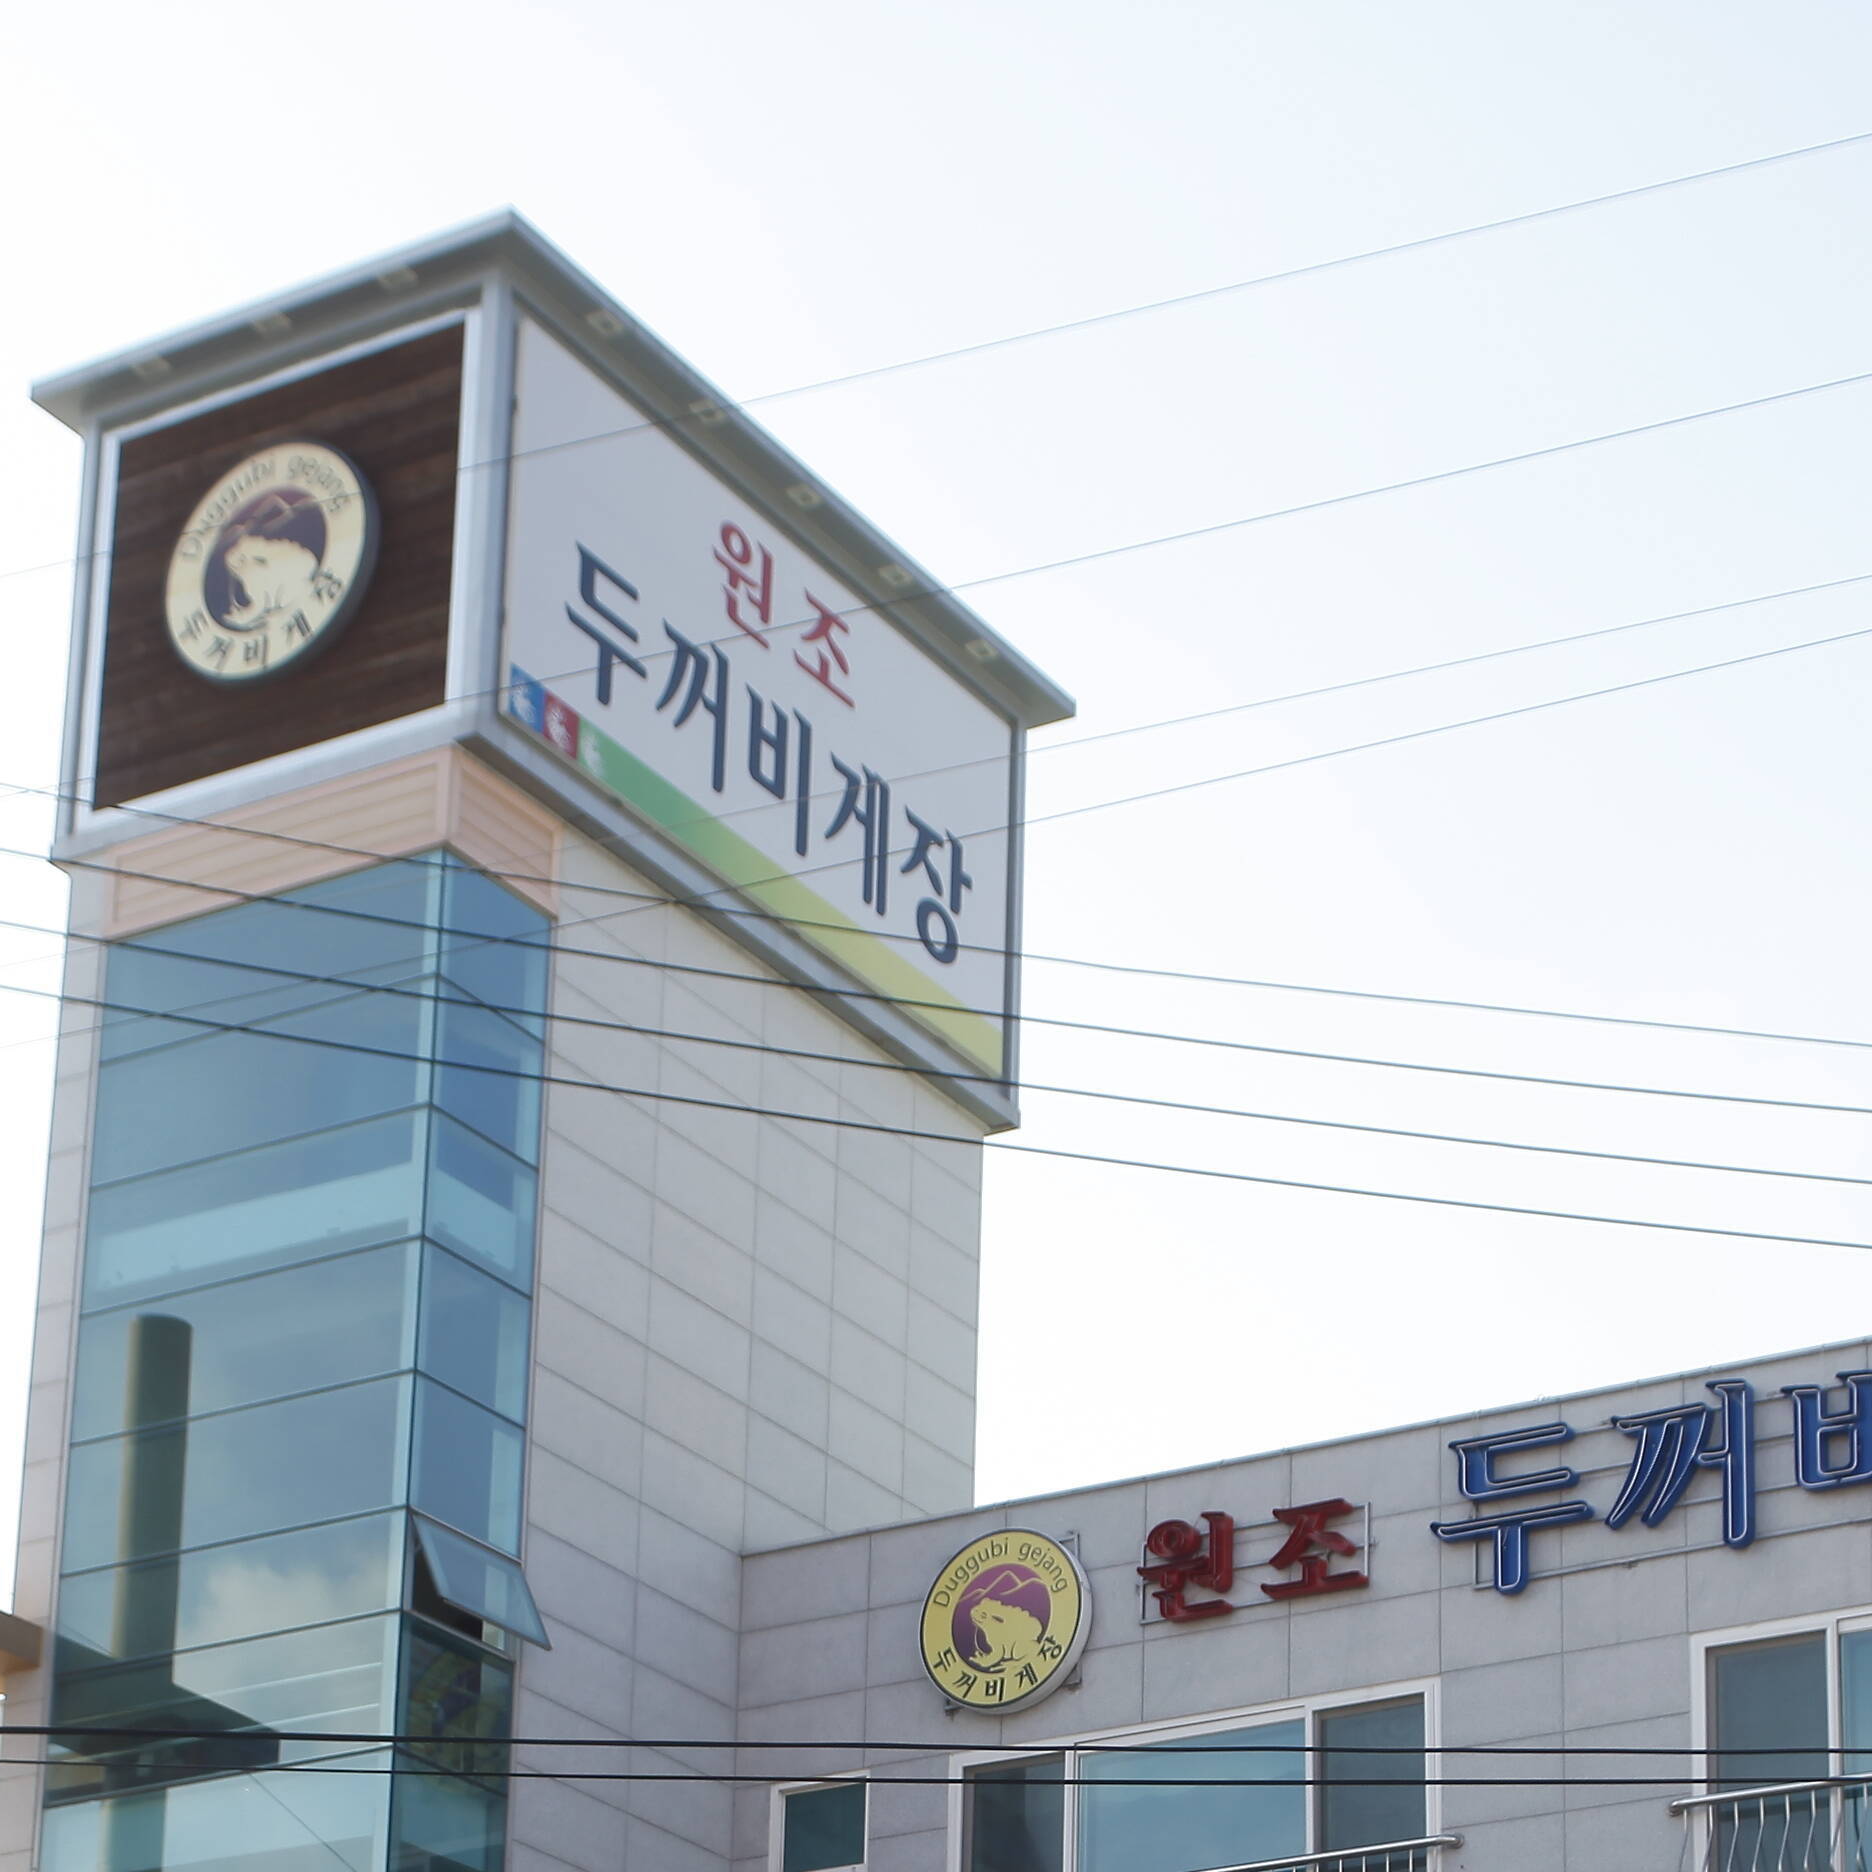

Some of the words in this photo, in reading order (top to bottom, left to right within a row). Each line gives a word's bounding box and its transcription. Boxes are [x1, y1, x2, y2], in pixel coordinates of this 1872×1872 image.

[180, 569, 343, 676] 두꺼비게장
[712, 520, 855, 708] 원조
[564, 541, 972, 964] 두꺼비게장
[933, 1537, 1009, 1608] Duggubi
[1017, 1542, 1068, 1594] gejang
[1137, 1497, 1370, 1621] 원조
[933, 1635, 1062, 1702] 두꺼비게장
